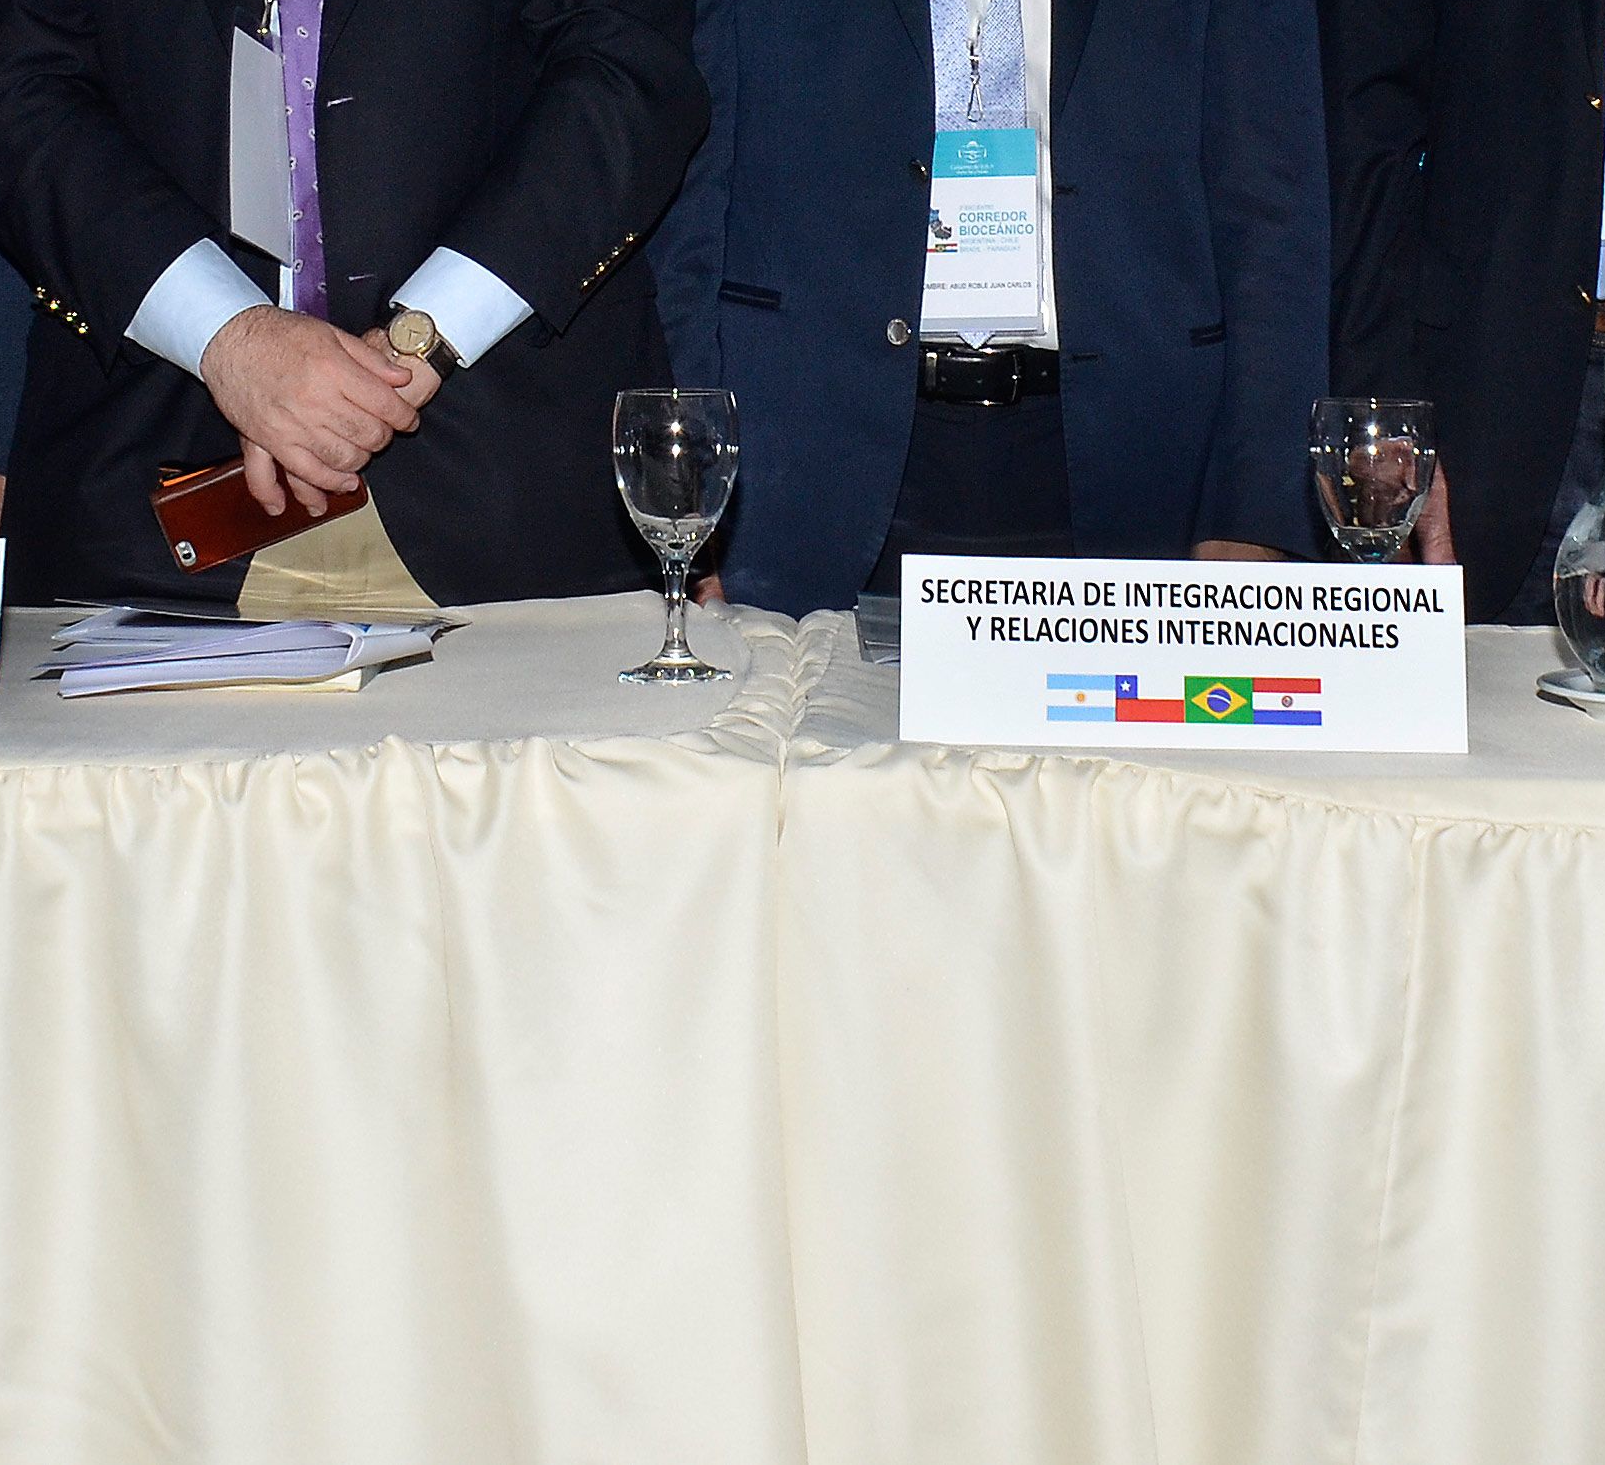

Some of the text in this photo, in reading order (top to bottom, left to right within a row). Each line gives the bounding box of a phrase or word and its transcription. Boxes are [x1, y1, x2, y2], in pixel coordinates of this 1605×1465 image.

[958, 211, 1028, 223] CORREDOR
[958, 221, 1035, 236] BIOCEÁNICO
[1006, 281, 1032, 289] CARLOS
[920, 578, 1444, 613] SECRETARIA DE INTEGRACION REGIONAL
[966, 615, 1400, 649] Y RELACIONES INTERNACIONALES
